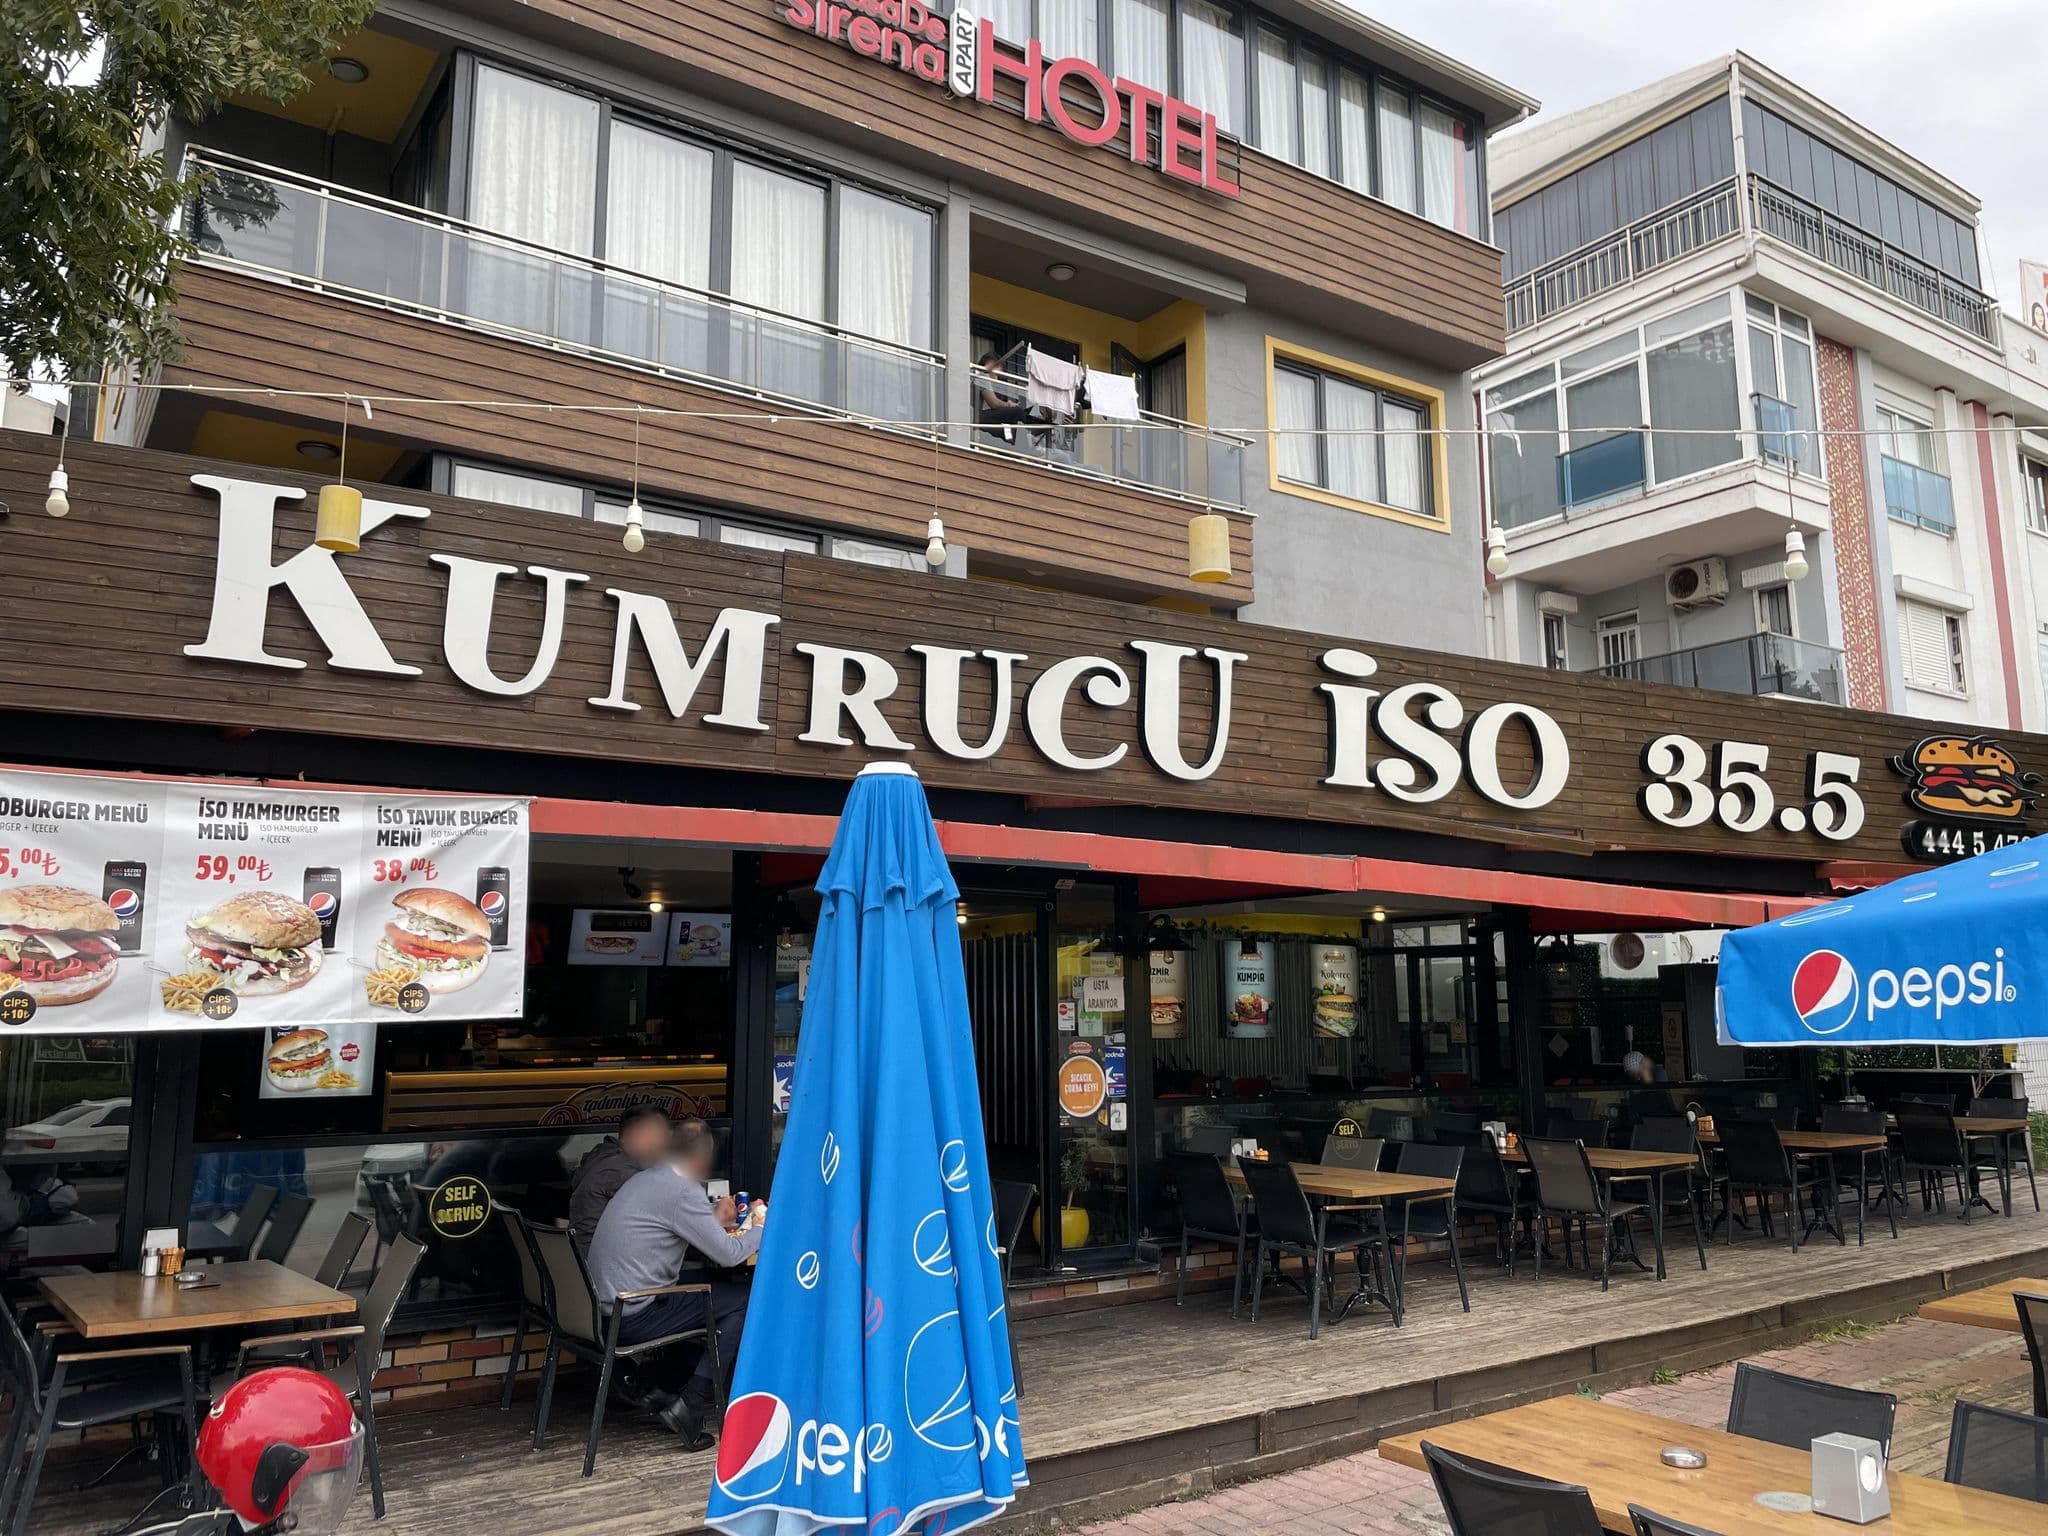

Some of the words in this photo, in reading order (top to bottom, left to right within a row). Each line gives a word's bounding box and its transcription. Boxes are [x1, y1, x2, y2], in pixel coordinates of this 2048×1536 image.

[785, 0, 945, 84] Sirena
[956, 13, 973, 88] APART
[976, 18, 1240, 196] HOTEL
[184, 473, 1249, 780] KUMRUCU
[1643, 734, 1865, 840] 35.5
[94, 803, 148, 823] MENÜ
[198, 797, 227, 818] İSO
[232, 802, 340, 822] HAMBURGER
[377, 805, 403, 825] İSO
[407, 809, 457, 826] TAVUK
[460, 810, 518, 827] BURGER
[198, 822, 249, 841] MENÜ
[376, 828, 422, 847] MENÜ
[1972, 830, 1986, 856] 5
[1093, 980, 1110, 991] USTA
[1867, 947, 2004, 1022] pepsi
[1338, 1124, 1355, 1136] SELF
[444, 1185, 477, 1202] SELF
